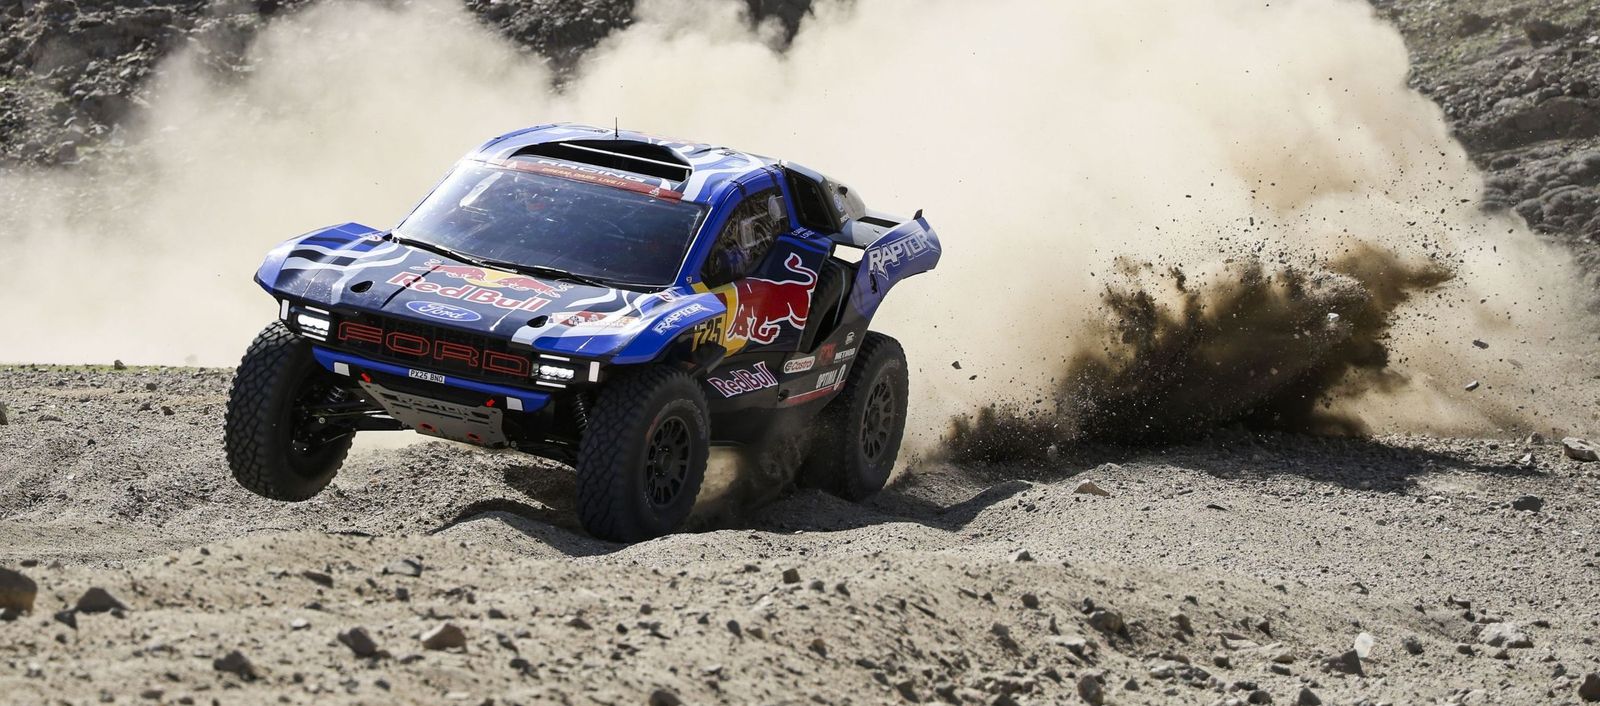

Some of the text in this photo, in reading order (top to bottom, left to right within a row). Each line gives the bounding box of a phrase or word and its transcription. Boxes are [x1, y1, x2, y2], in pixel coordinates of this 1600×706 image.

[868, 231, 930, 280] RAPTOR
[385, 271, 552, 312] Red Bull
[418, 303, 468, 320] Ford
[652, 303, 704, 335] RAPTOR
[338, 321, 530, 377] FORD
[410, 369, 428, 380] PX25
[707, 361, 779, 398] Red Bull
